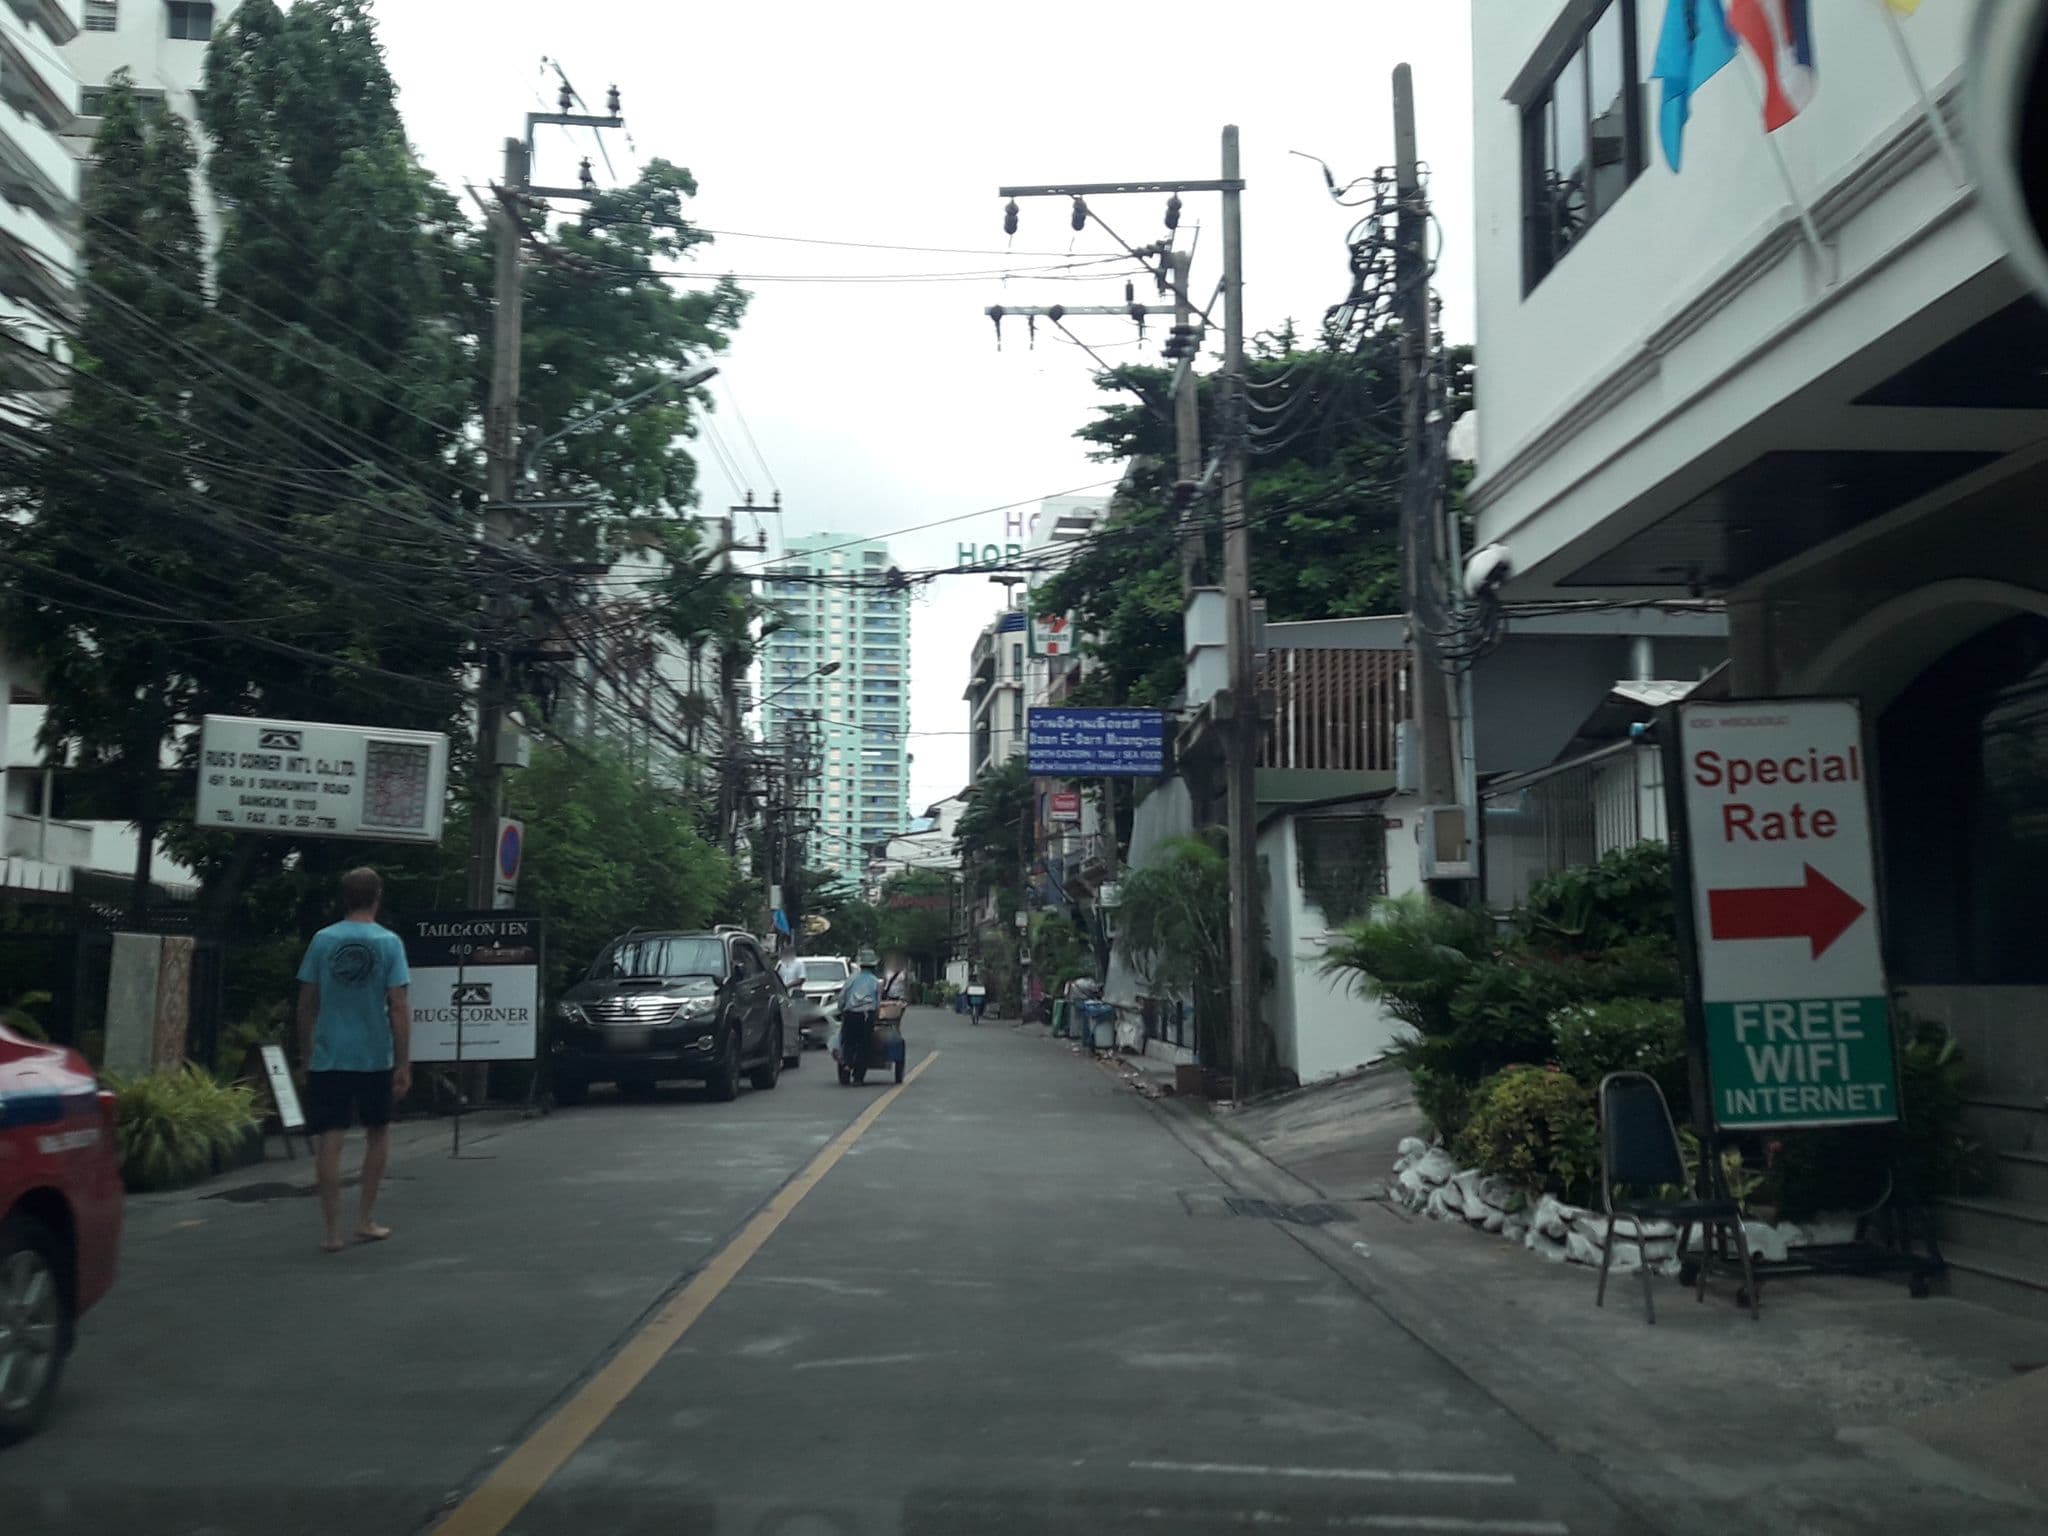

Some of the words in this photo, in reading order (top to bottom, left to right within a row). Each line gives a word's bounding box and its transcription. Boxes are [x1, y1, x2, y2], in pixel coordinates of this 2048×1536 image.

[240, 752, 281, 771] CORNER
[1694, 746, 1860, 794] Special
[239, 795, 288, 809] BANGKOK
[259, 778, 318, 793] SUKHUMVIT
[323, 782, 351, 795] ROAD
[1722, 803, 1838, 842] Rate
[474, 922, 495, 936] ON
[1733, 1000, 1864, 1043] FREE
[1744, 1042, 1850, 1084] WIFI
[1725, 1083, 1887, 1115] INTERNET
